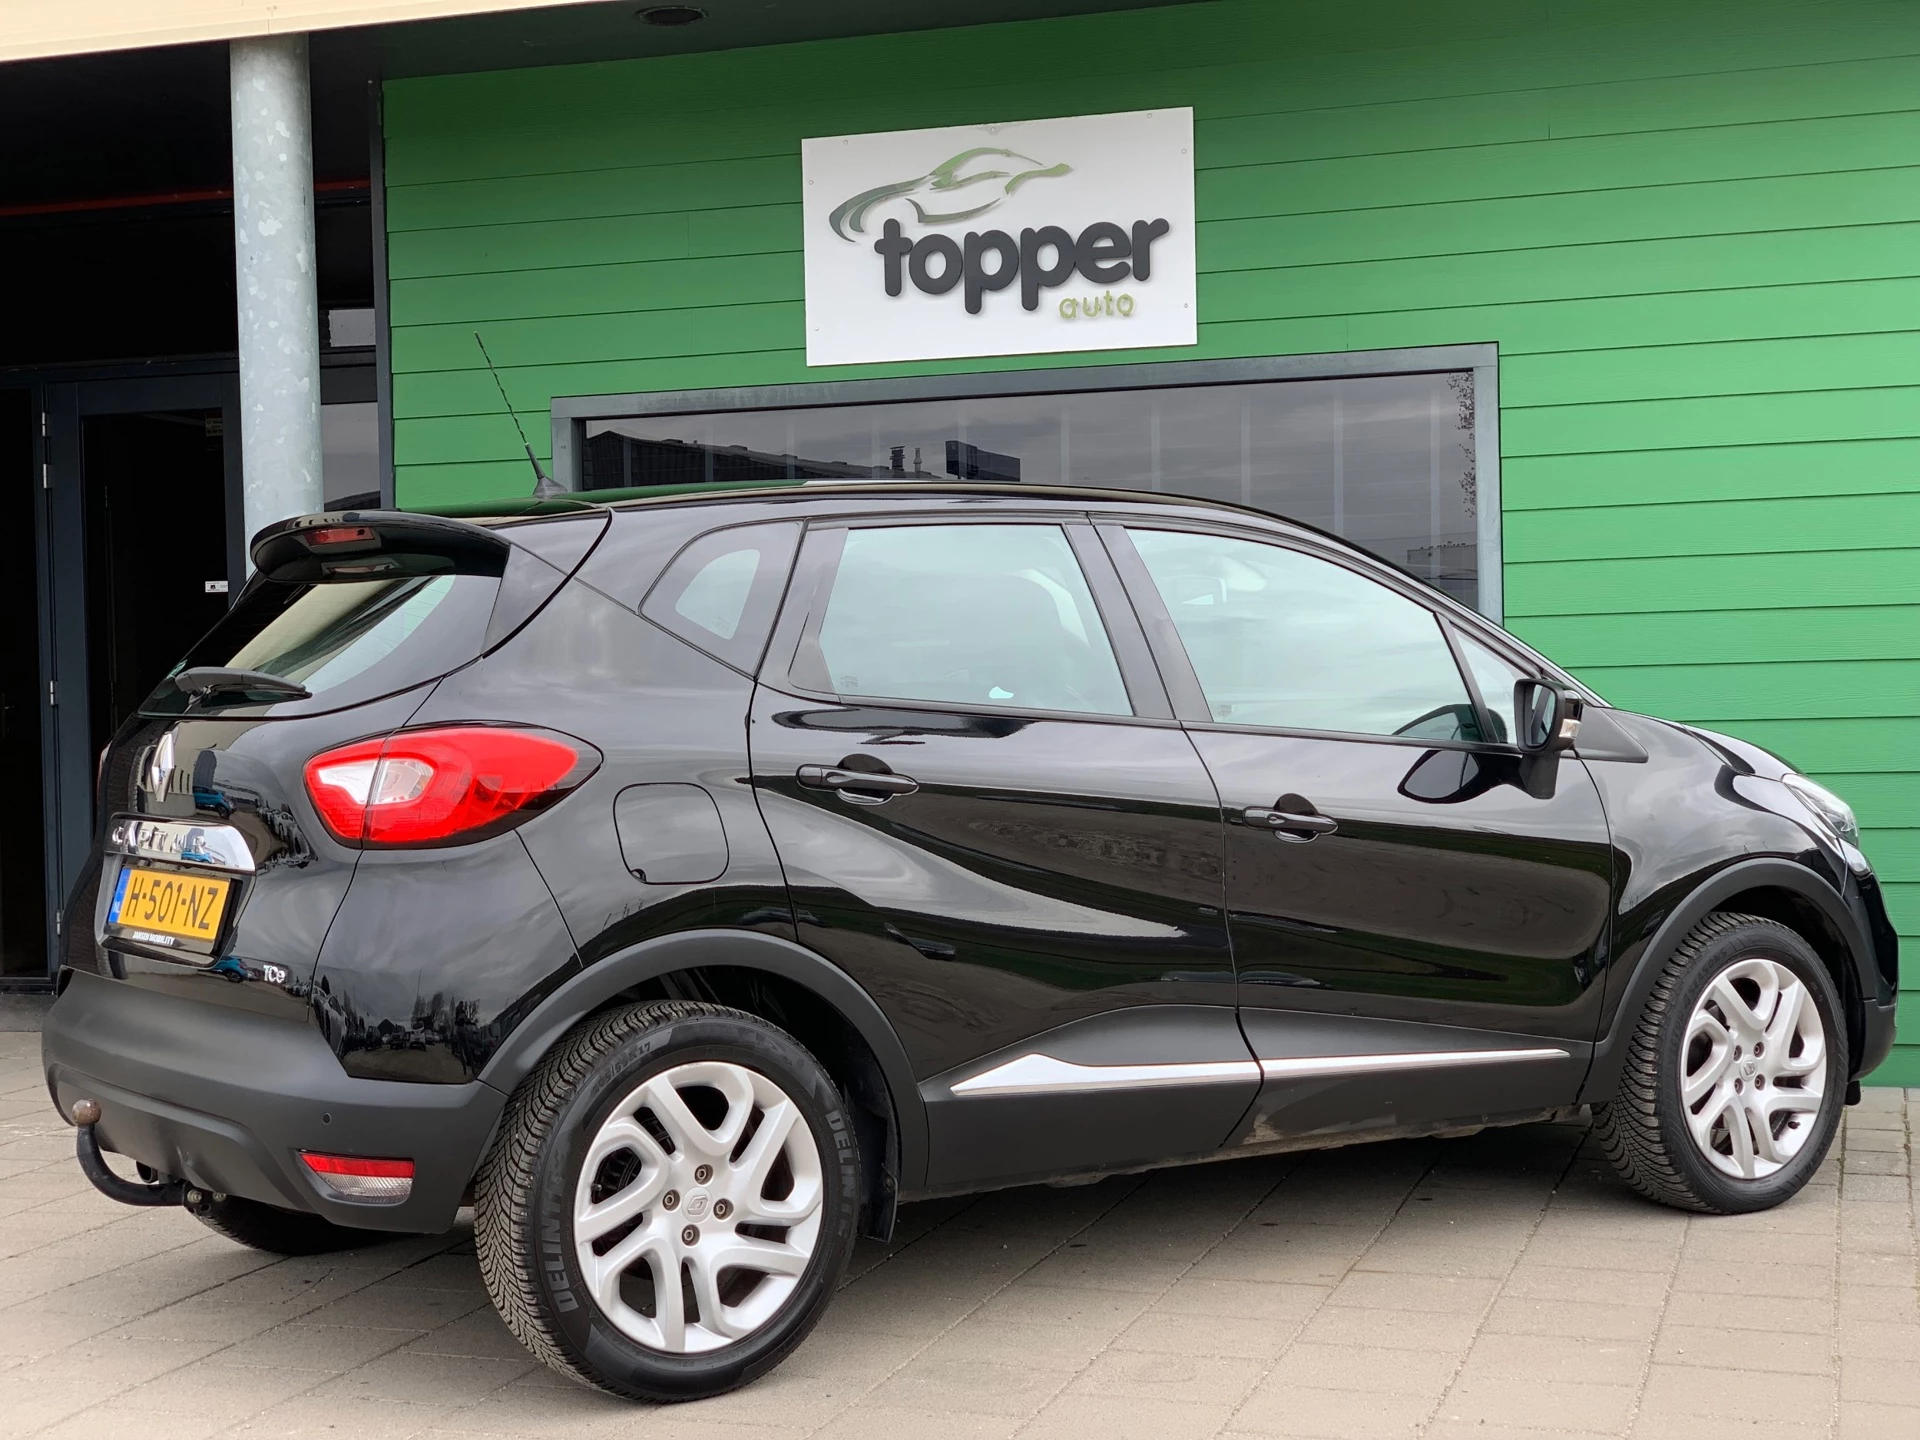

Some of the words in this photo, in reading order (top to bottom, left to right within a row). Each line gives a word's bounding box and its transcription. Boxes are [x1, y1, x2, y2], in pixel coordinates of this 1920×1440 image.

[874, 217, 1170, 315] topper
[1058, 290, 1134, 320] auto
[112, 822, 206, 856] CAPTUR
[125, 876, 219, 930] H-501-NZ
[263, 964, 286, 984] TCe
